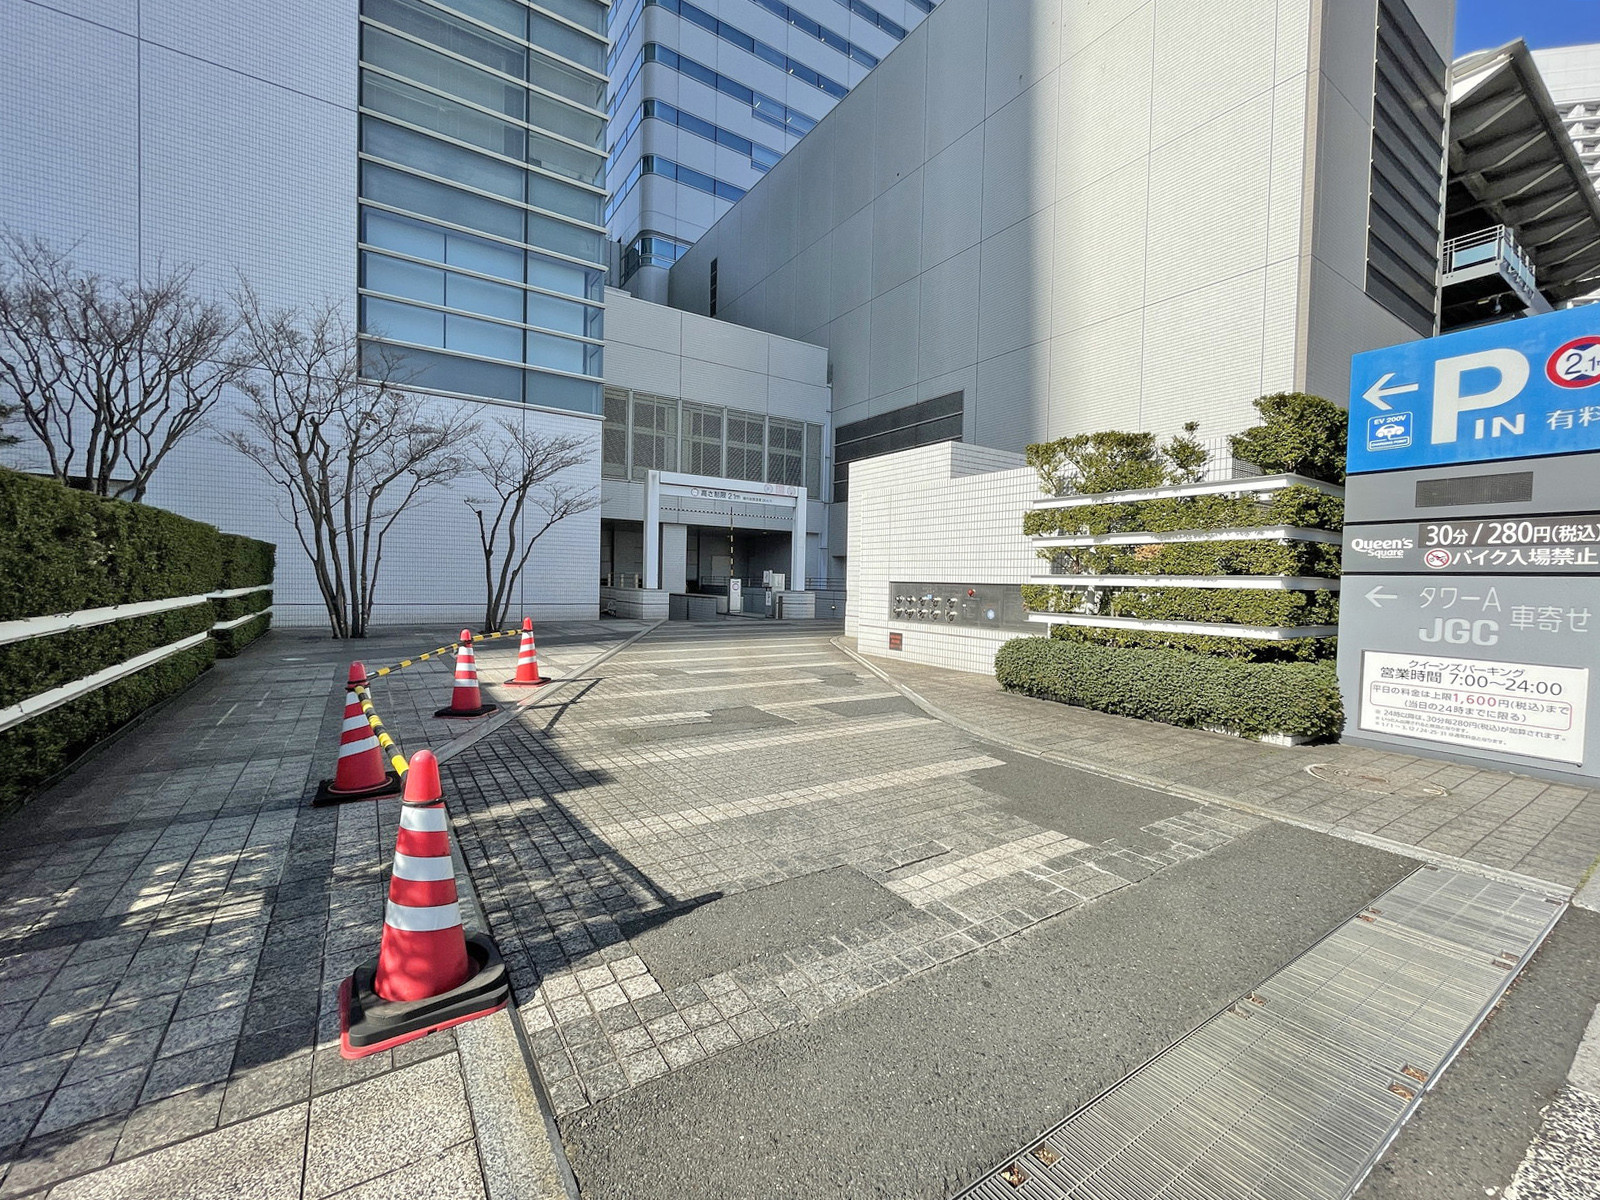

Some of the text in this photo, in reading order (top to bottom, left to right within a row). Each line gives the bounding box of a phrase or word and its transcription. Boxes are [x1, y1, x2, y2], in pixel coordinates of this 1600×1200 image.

[1565, 353, 1600, 375] 2.1
[1431, 348, 1530, 445] P
[1386, 414, 1407, 423] 200V
[1474, 413, 1525, 440] IN
[1351, 537, 1413, 553] Queen's
[1367, 549, 1404, 559] Square
[1452, 547, 1599, 566] バイク入場禁止
[1419, 587, 1502, 612] タワーA
[1509, 605, 1592, 633] 車寄せ
[1418, 617, 1499, 646] JGC
[1380, 667, 1442, 684] 営業時間
